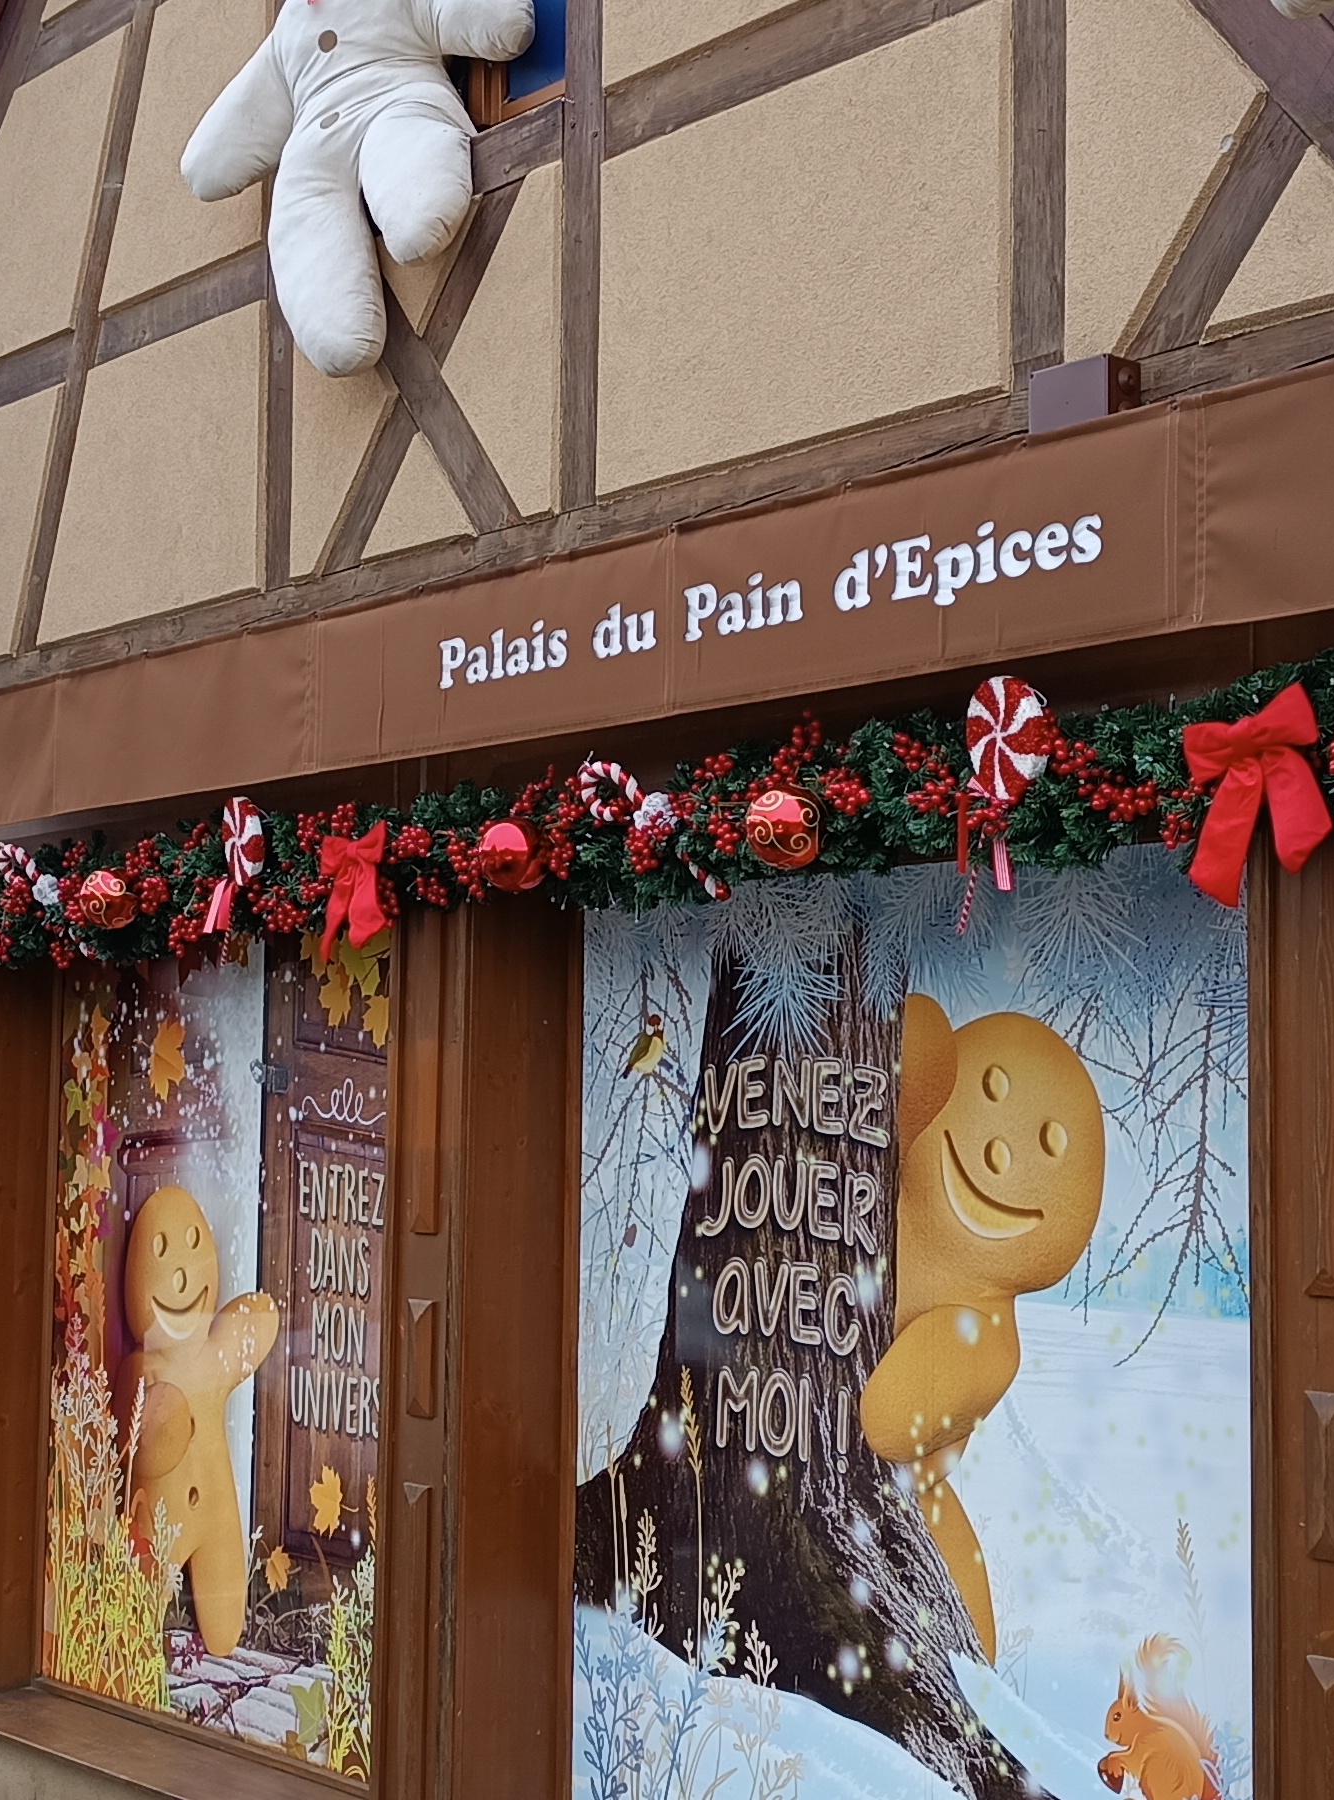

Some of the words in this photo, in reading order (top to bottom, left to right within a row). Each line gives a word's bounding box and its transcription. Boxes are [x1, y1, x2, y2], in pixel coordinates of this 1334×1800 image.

[438, 619, 568, 690] Palais
[591, 602, 657, 661] du
[682, 571, 804, 643] Pain
[833, 512, 1103, 607] d'Epices
[704, 1055, 891, 1149] VENEZ
[299, 1160, 386, 1227] ENTREZ
[701, 1153, 878, 1256] JOUER
[309, 1228, 370, 1297] DANS
[310, 1299, 366, 1365] MON
[290, 1365, 381, 1439] UNIVERS
[715, 1366, 812, 1463] MOI
